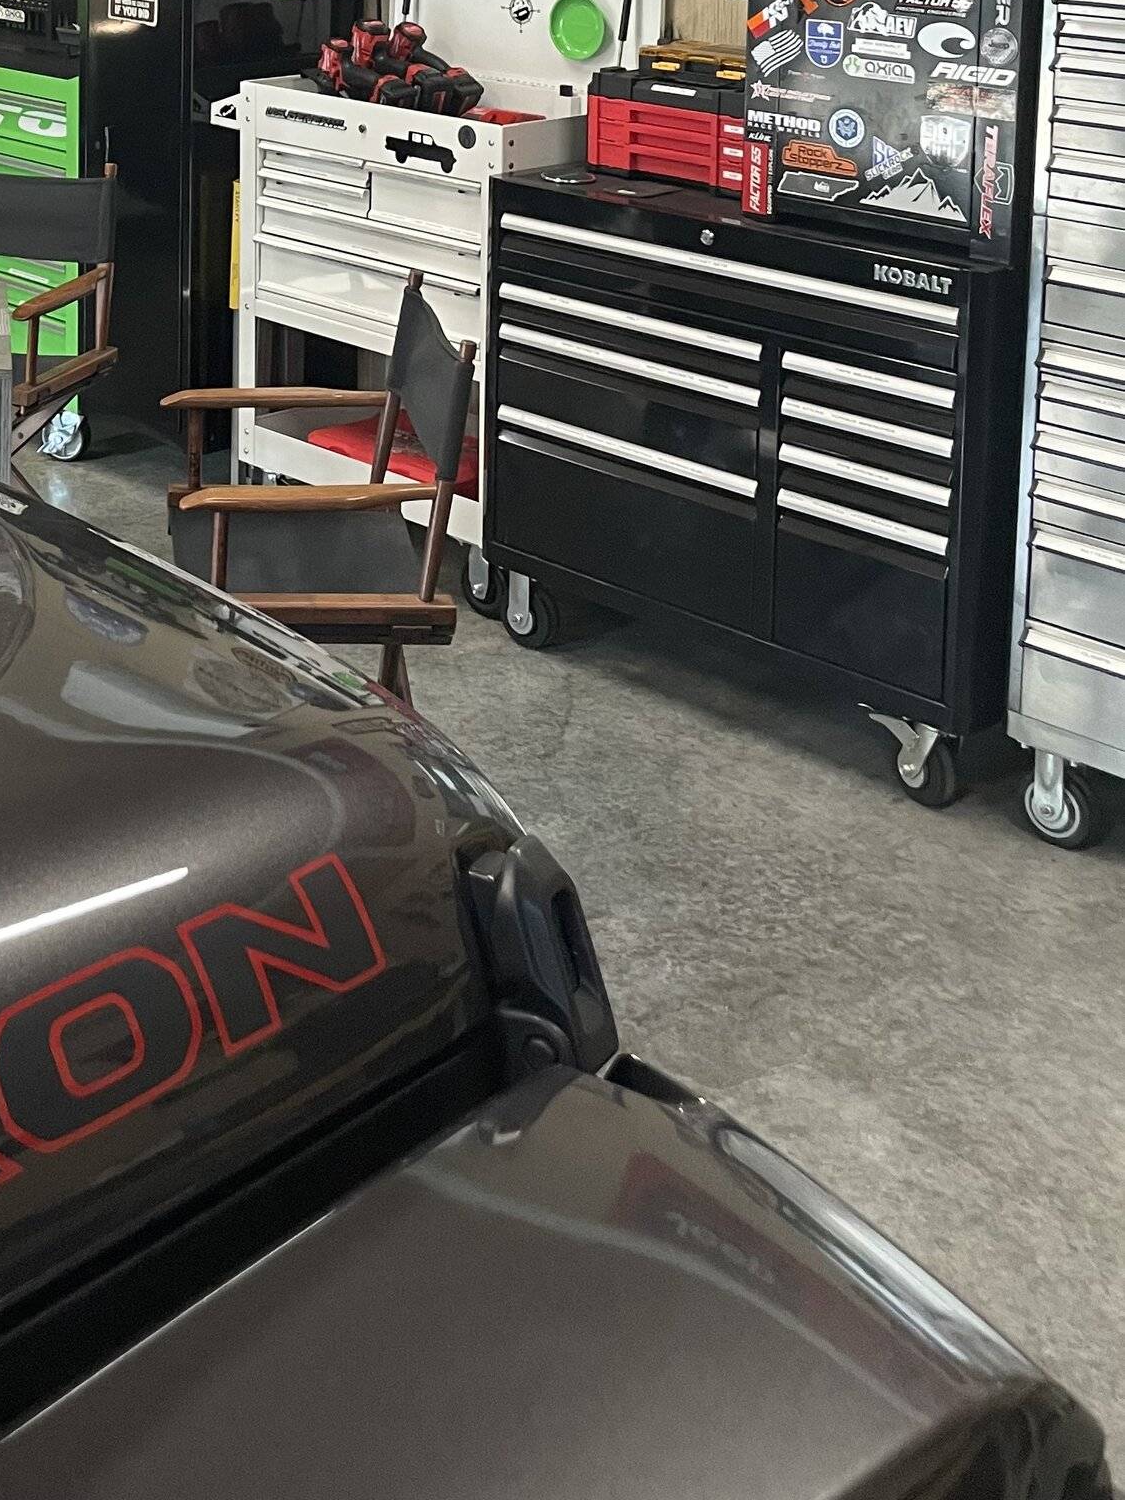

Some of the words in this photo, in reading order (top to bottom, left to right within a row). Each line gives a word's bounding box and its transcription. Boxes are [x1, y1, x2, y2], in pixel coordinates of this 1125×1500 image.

[121, 5, 138, 18] YOU
[930, 61, 1017, 87] RIGID
[747, 109, 822, 132] METHOD
[747, 121, 773, 131] RACE
[776, 127, 822, 139] WHEELS
[750, 145, 762, 165] 55
[749, 165, 762, 212] FACTOR
[873, 263, 953, 296] KOBALT
